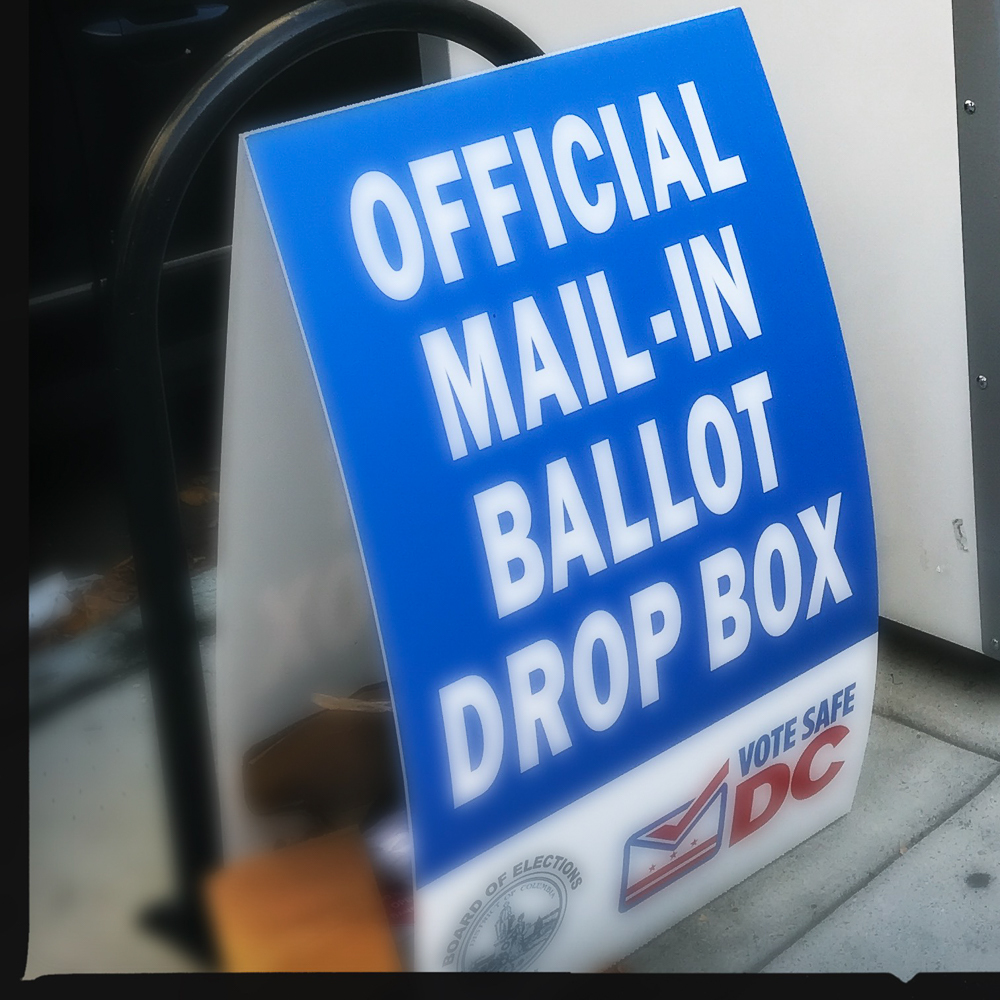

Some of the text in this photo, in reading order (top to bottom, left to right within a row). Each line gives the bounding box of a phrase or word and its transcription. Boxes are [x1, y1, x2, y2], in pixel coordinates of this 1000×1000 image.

[349, 80, 748, 301] OFFICIAL
[419, 224, 763, 461] MAIL-IN
[473, 371, 780, 619] BALLOT
[437, 492, 853, 808] DROP BOX
[738, 682, 856, 777] VOTE SAFE
[729, 725, 850, 848] DC
[442, 900, 483, 967] BOARD
[485, 872, 507, 896] OF
[513, 855, 582, 890] ELECTIONS
